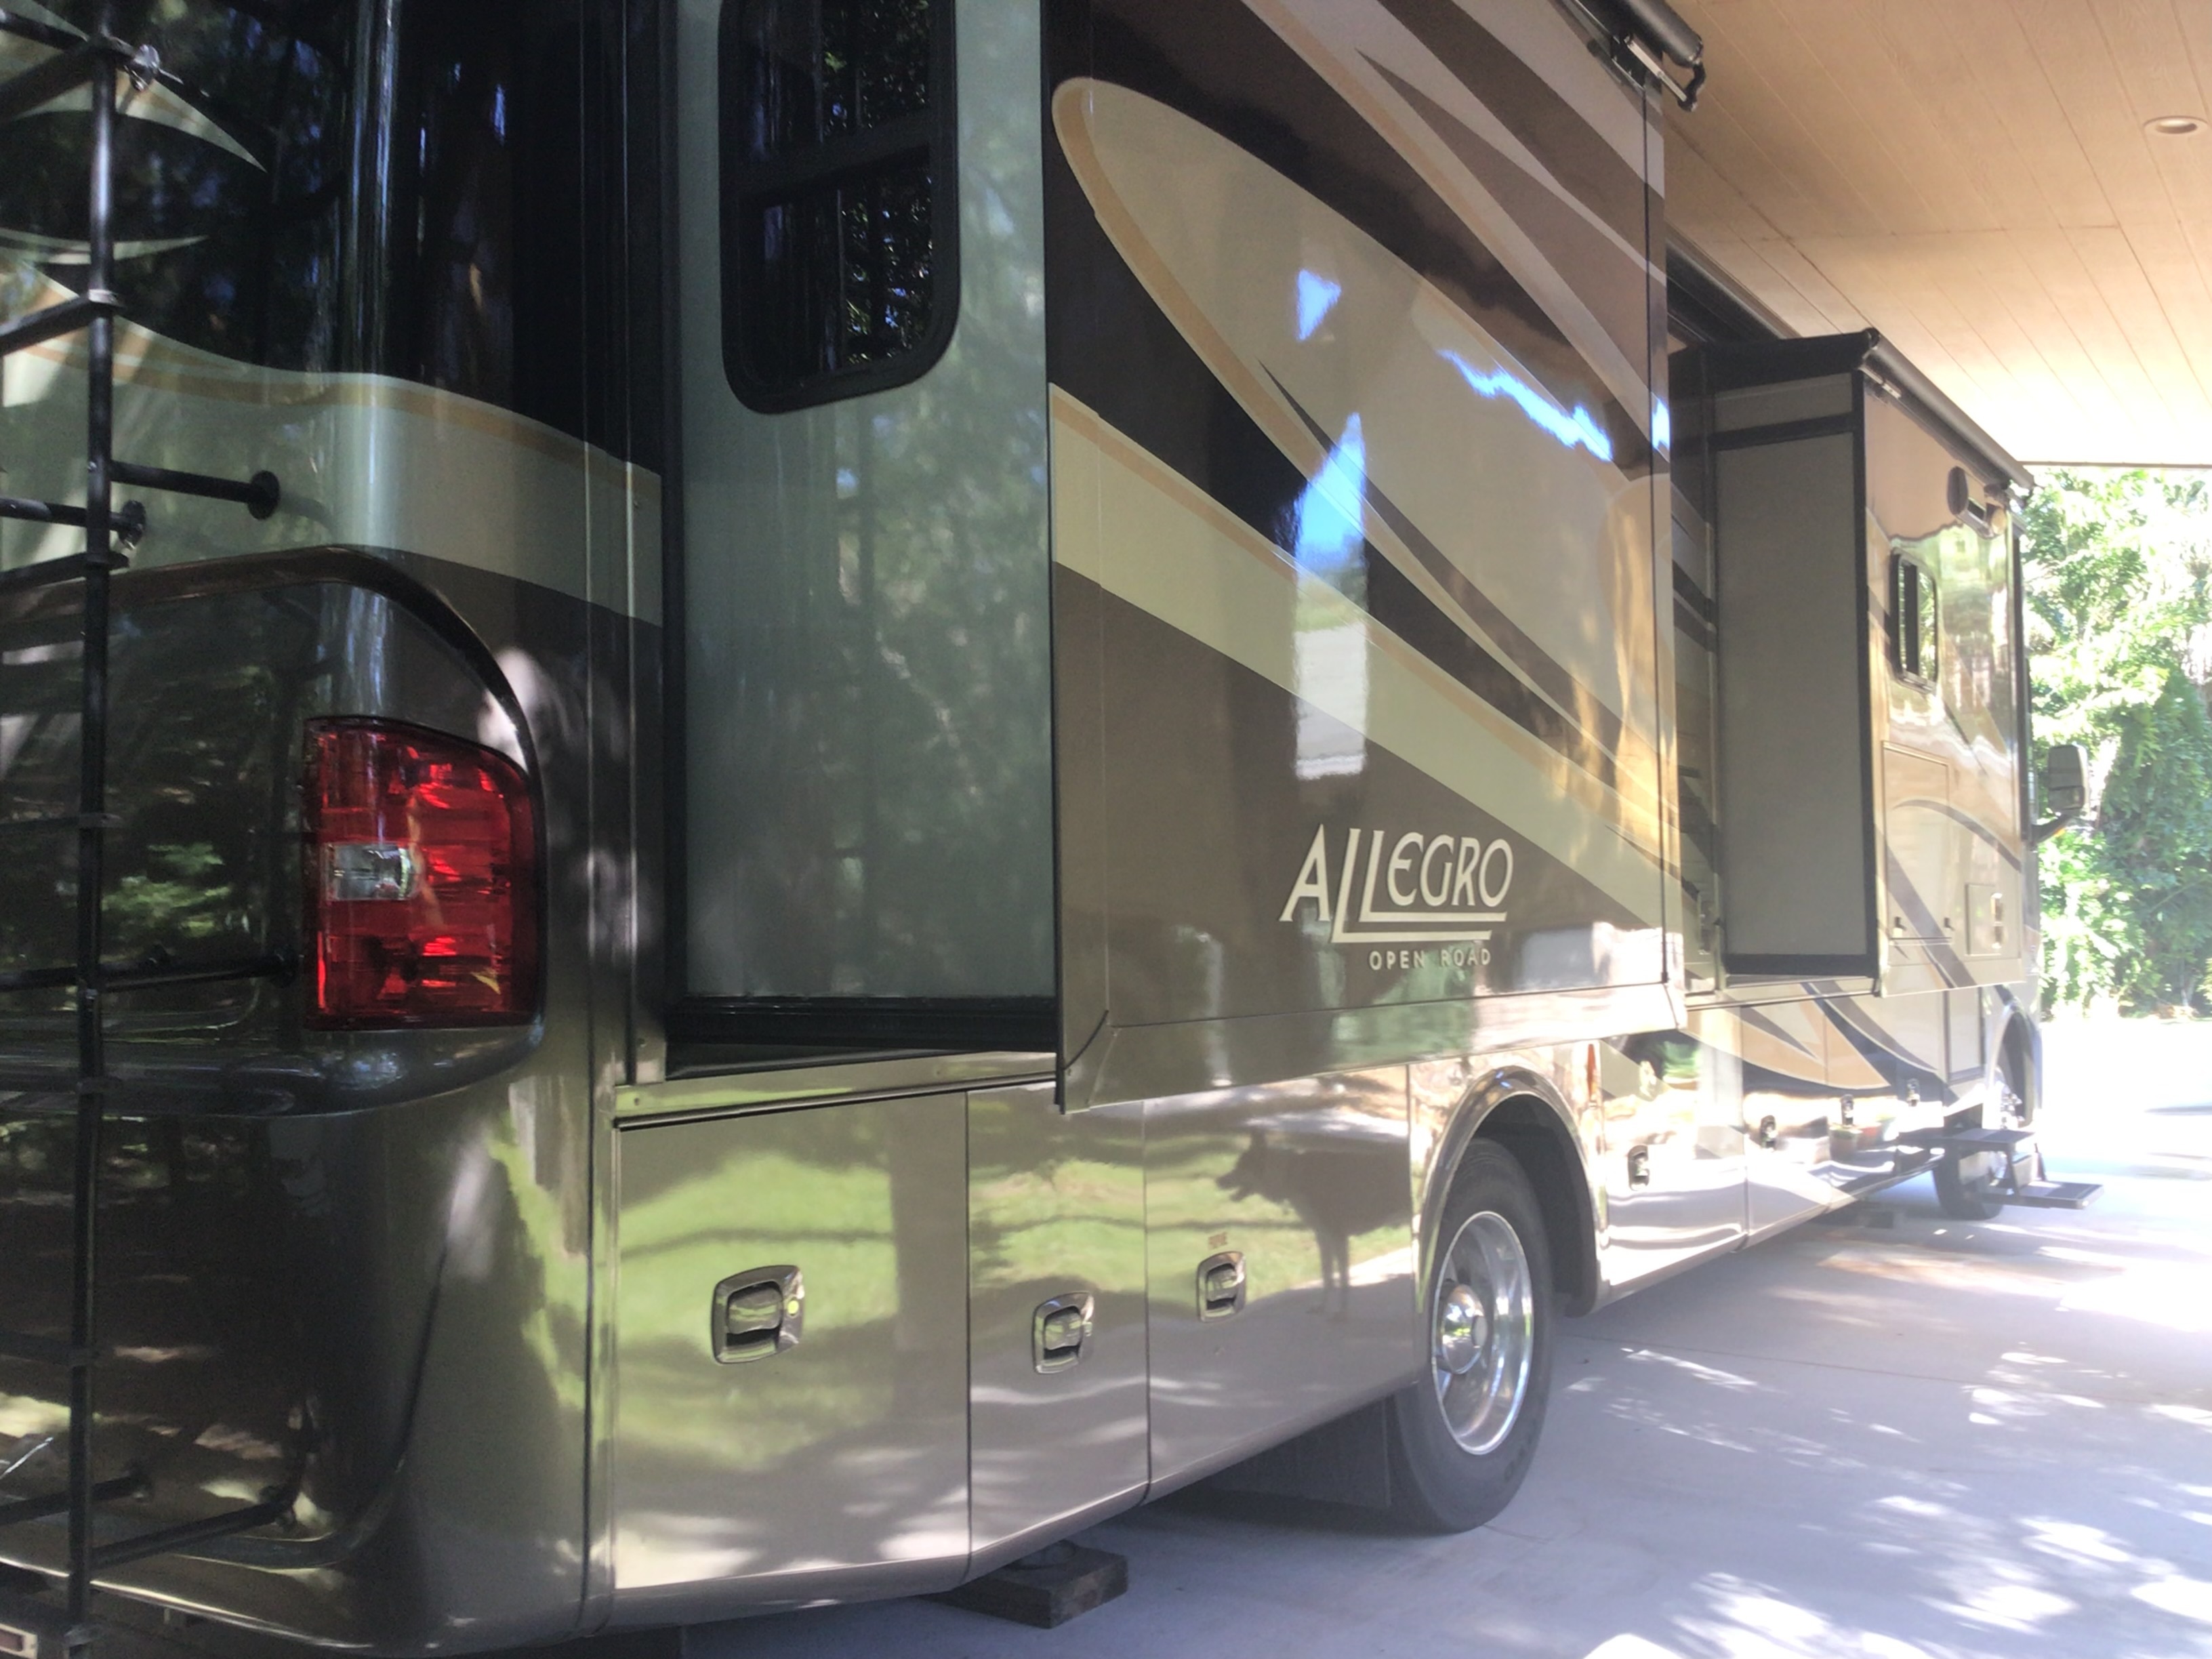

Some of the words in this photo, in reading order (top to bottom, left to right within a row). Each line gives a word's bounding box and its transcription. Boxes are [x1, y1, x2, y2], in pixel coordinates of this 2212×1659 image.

[1279, 823, 1513, 943] ALLEGRO
[1368, 950, 1424, 970] OPEN
[1441, 948, 1491, 967] ROAD
